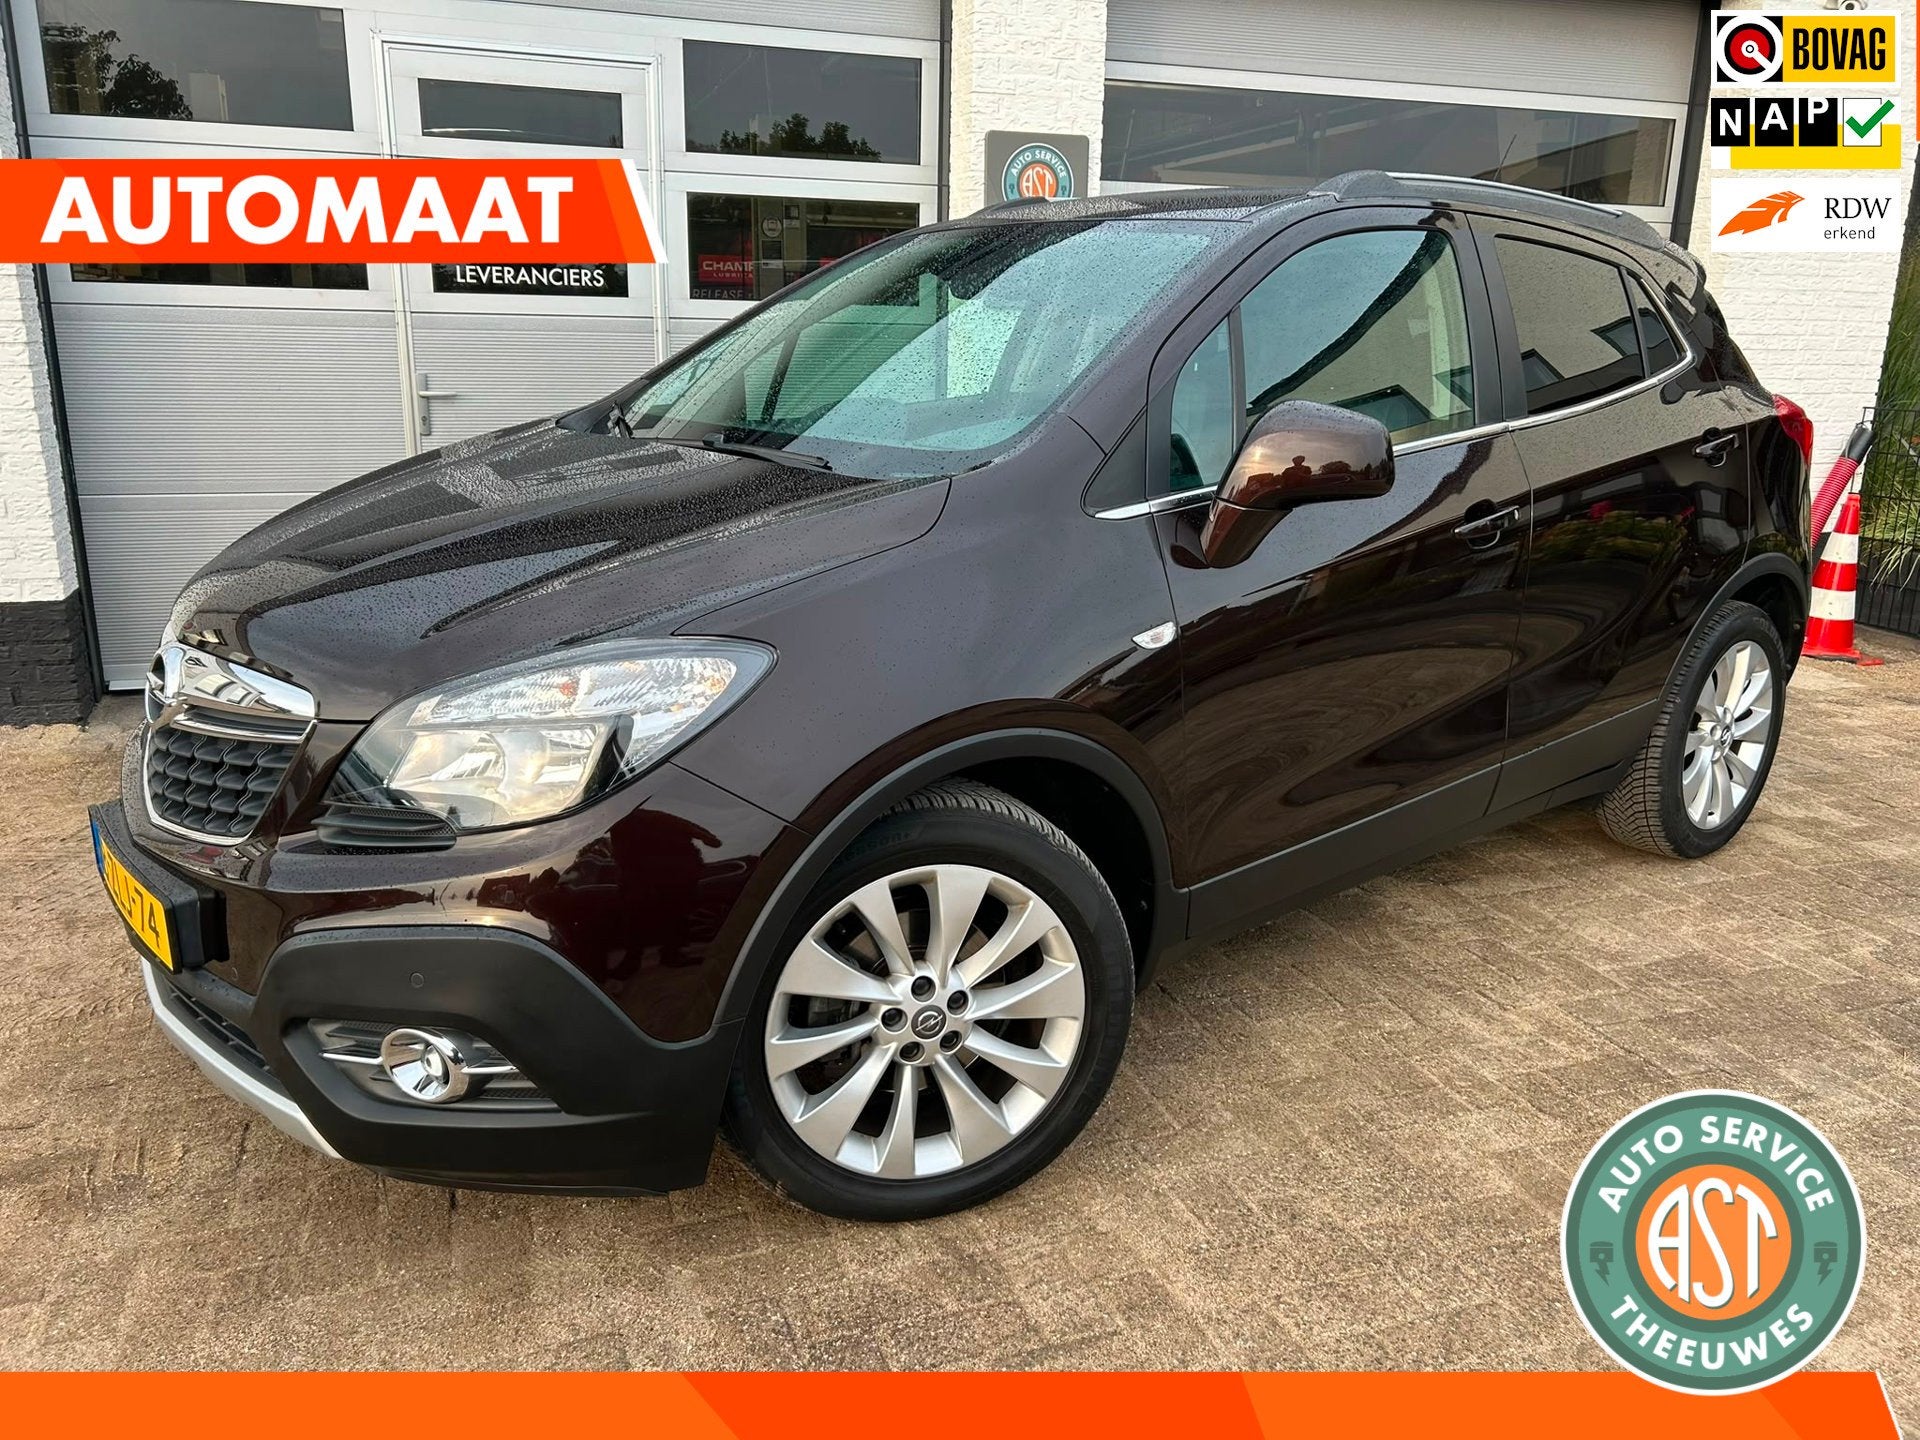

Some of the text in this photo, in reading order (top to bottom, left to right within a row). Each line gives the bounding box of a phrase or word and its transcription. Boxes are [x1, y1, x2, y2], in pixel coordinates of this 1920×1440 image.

[1010, 150, 1067, 178] AUTO SERVICE
[1022, 166, 1053, 198] AST
[456, 265, 605, 287] LEVERANCIERS
